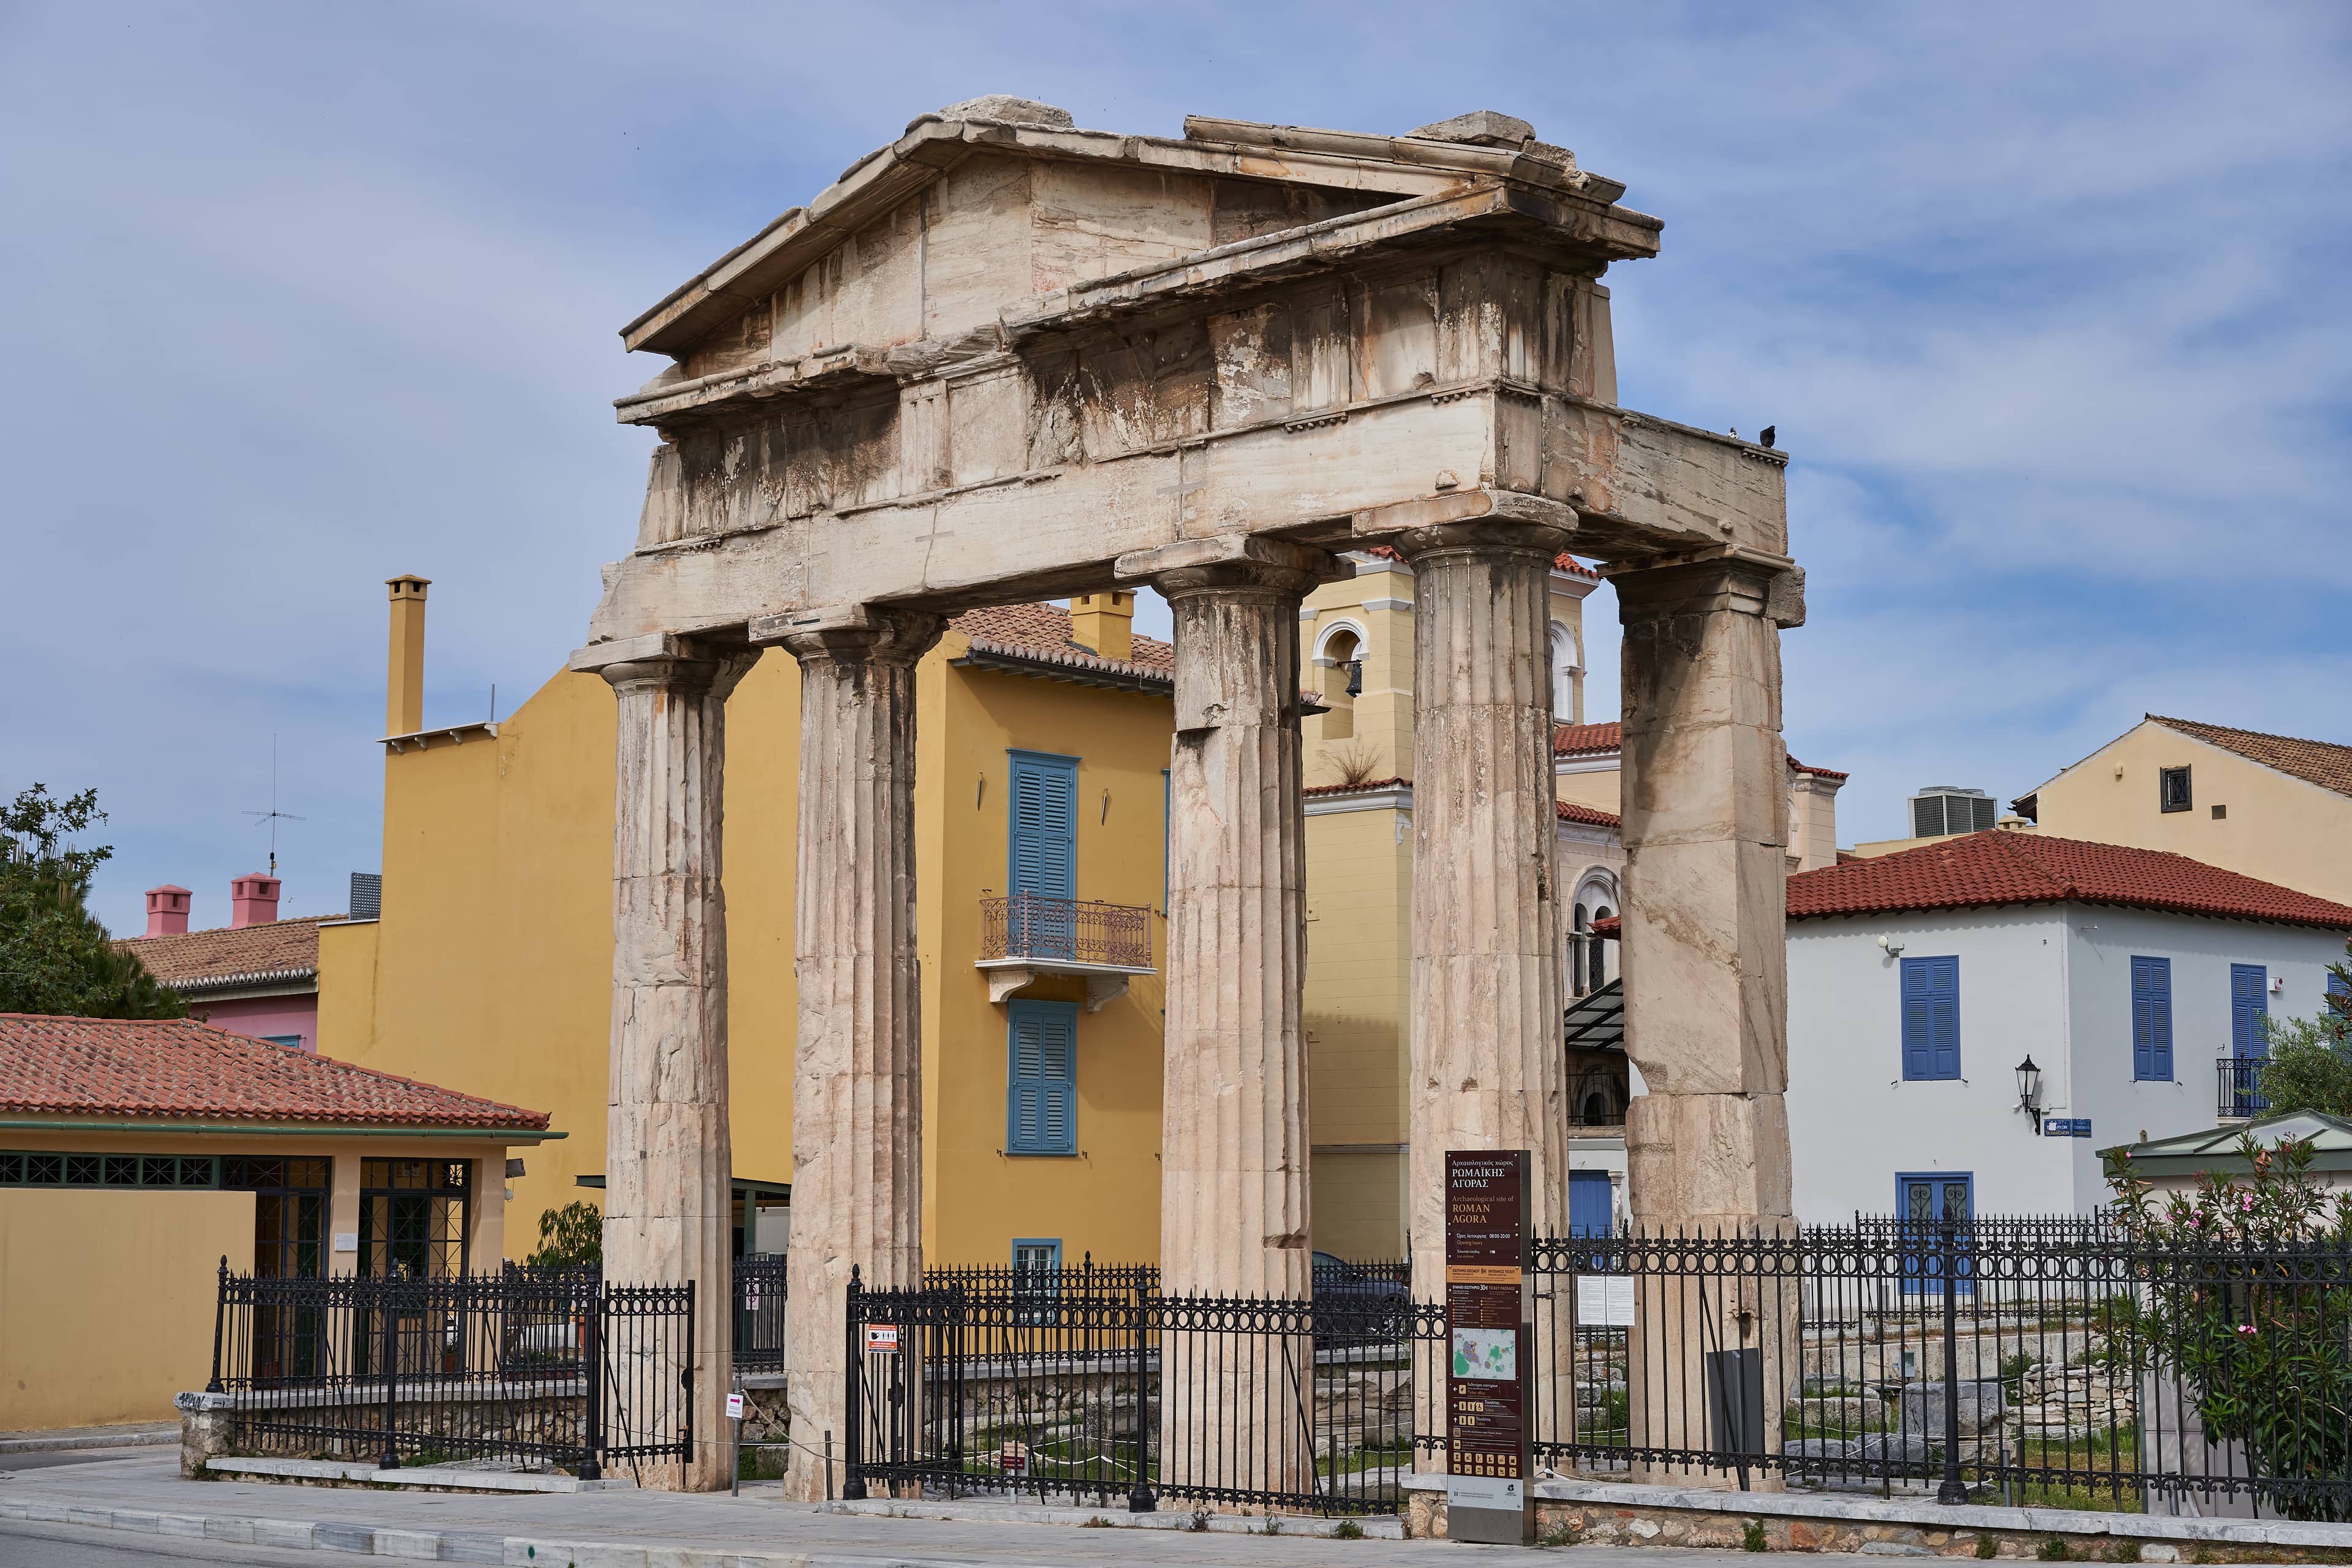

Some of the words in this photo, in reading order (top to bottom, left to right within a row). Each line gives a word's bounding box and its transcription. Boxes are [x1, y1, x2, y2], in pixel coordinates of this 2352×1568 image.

[1452, 1167, 1504, 1177] ΡΩΜΑΪΚΗΣ
[1452, 1204, 1490, 1213] ROMAN
[1452, 1215, 1487, 1223] AGORA
